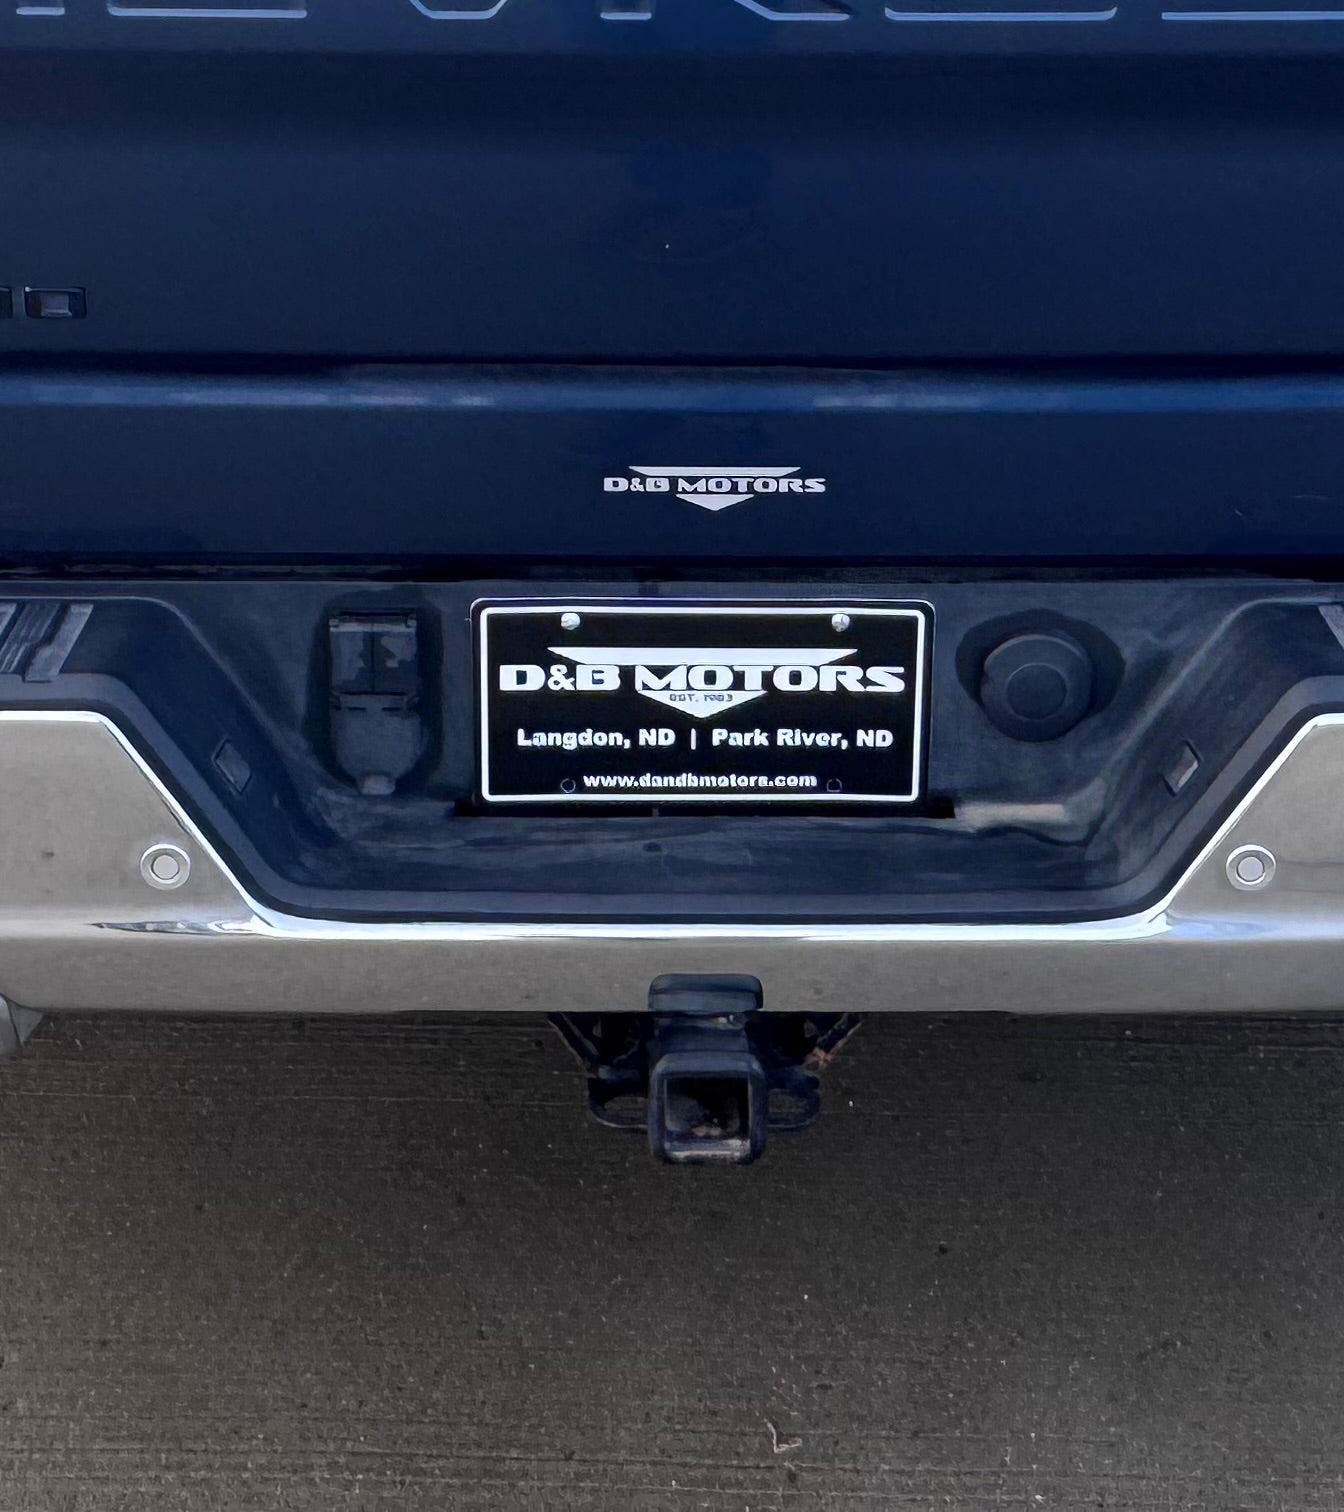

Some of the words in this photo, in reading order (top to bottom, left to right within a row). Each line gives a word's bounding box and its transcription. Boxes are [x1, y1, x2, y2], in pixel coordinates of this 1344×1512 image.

[603, 477, 671, 493] D&B
[677, 477, 826, 494] MOTORS
[499, 664, 622, 692] D&B
[634, 664, 905, 693] MOTORS
[516, 728, 632, 750] Langdon,
[638, 728, 676, 747] ND
[712, 728, 770, 747] Park
[776, 728, 849, 750] River,
[856, 729, 895, 748] ND
[583, 772, 818, 788] www.dandbmotors.com
